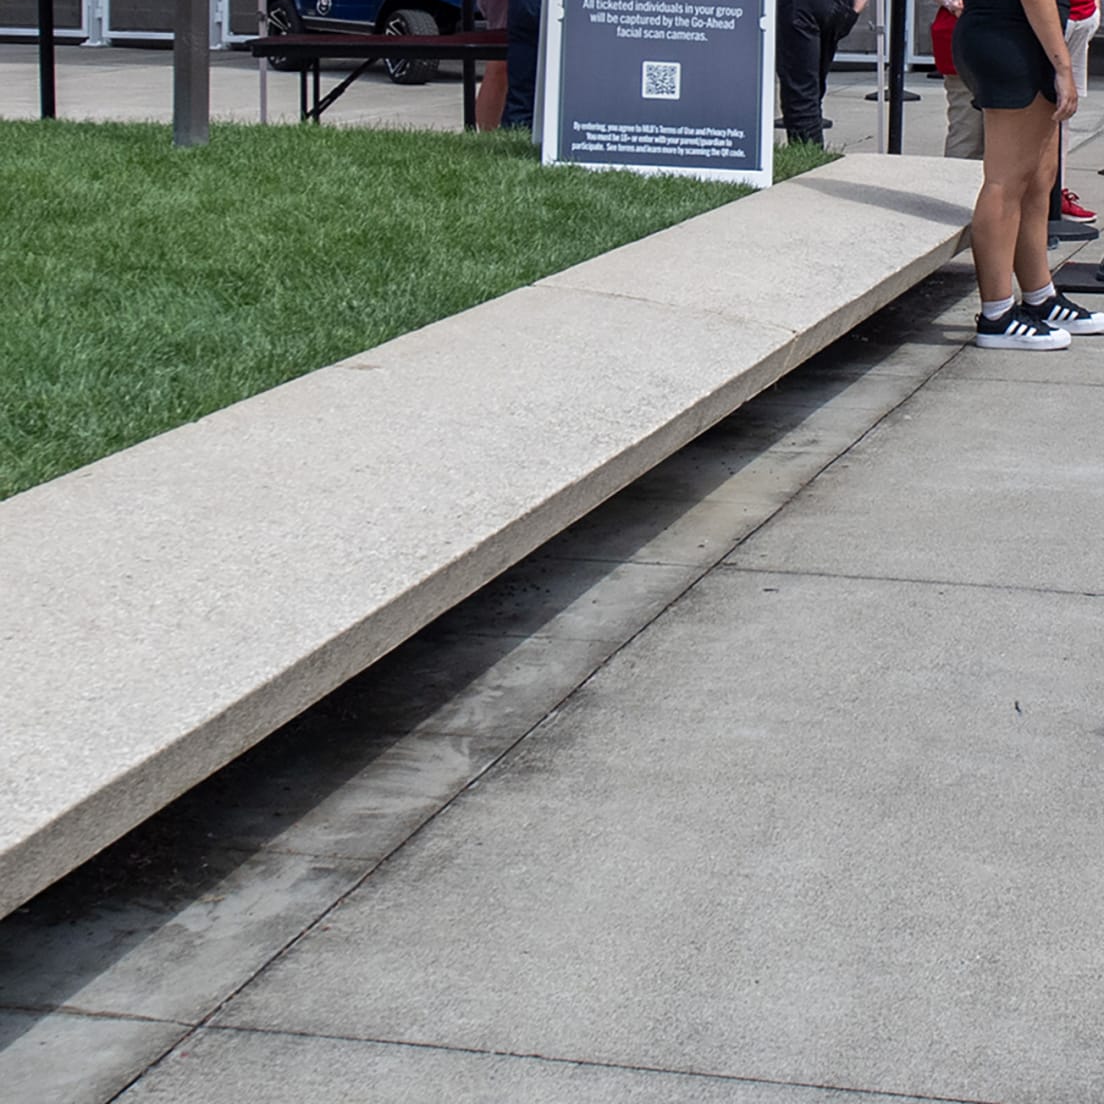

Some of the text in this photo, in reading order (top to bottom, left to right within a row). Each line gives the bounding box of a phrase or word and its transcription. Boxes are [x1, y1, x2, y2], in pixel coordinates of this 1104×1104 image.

[582, 0, 743, 18] All ticketed individuals in your group
[590, 13, 735, 30] will be captured by the Go-Ahead
[617, 27, 708, 41] facial scan cameras.
